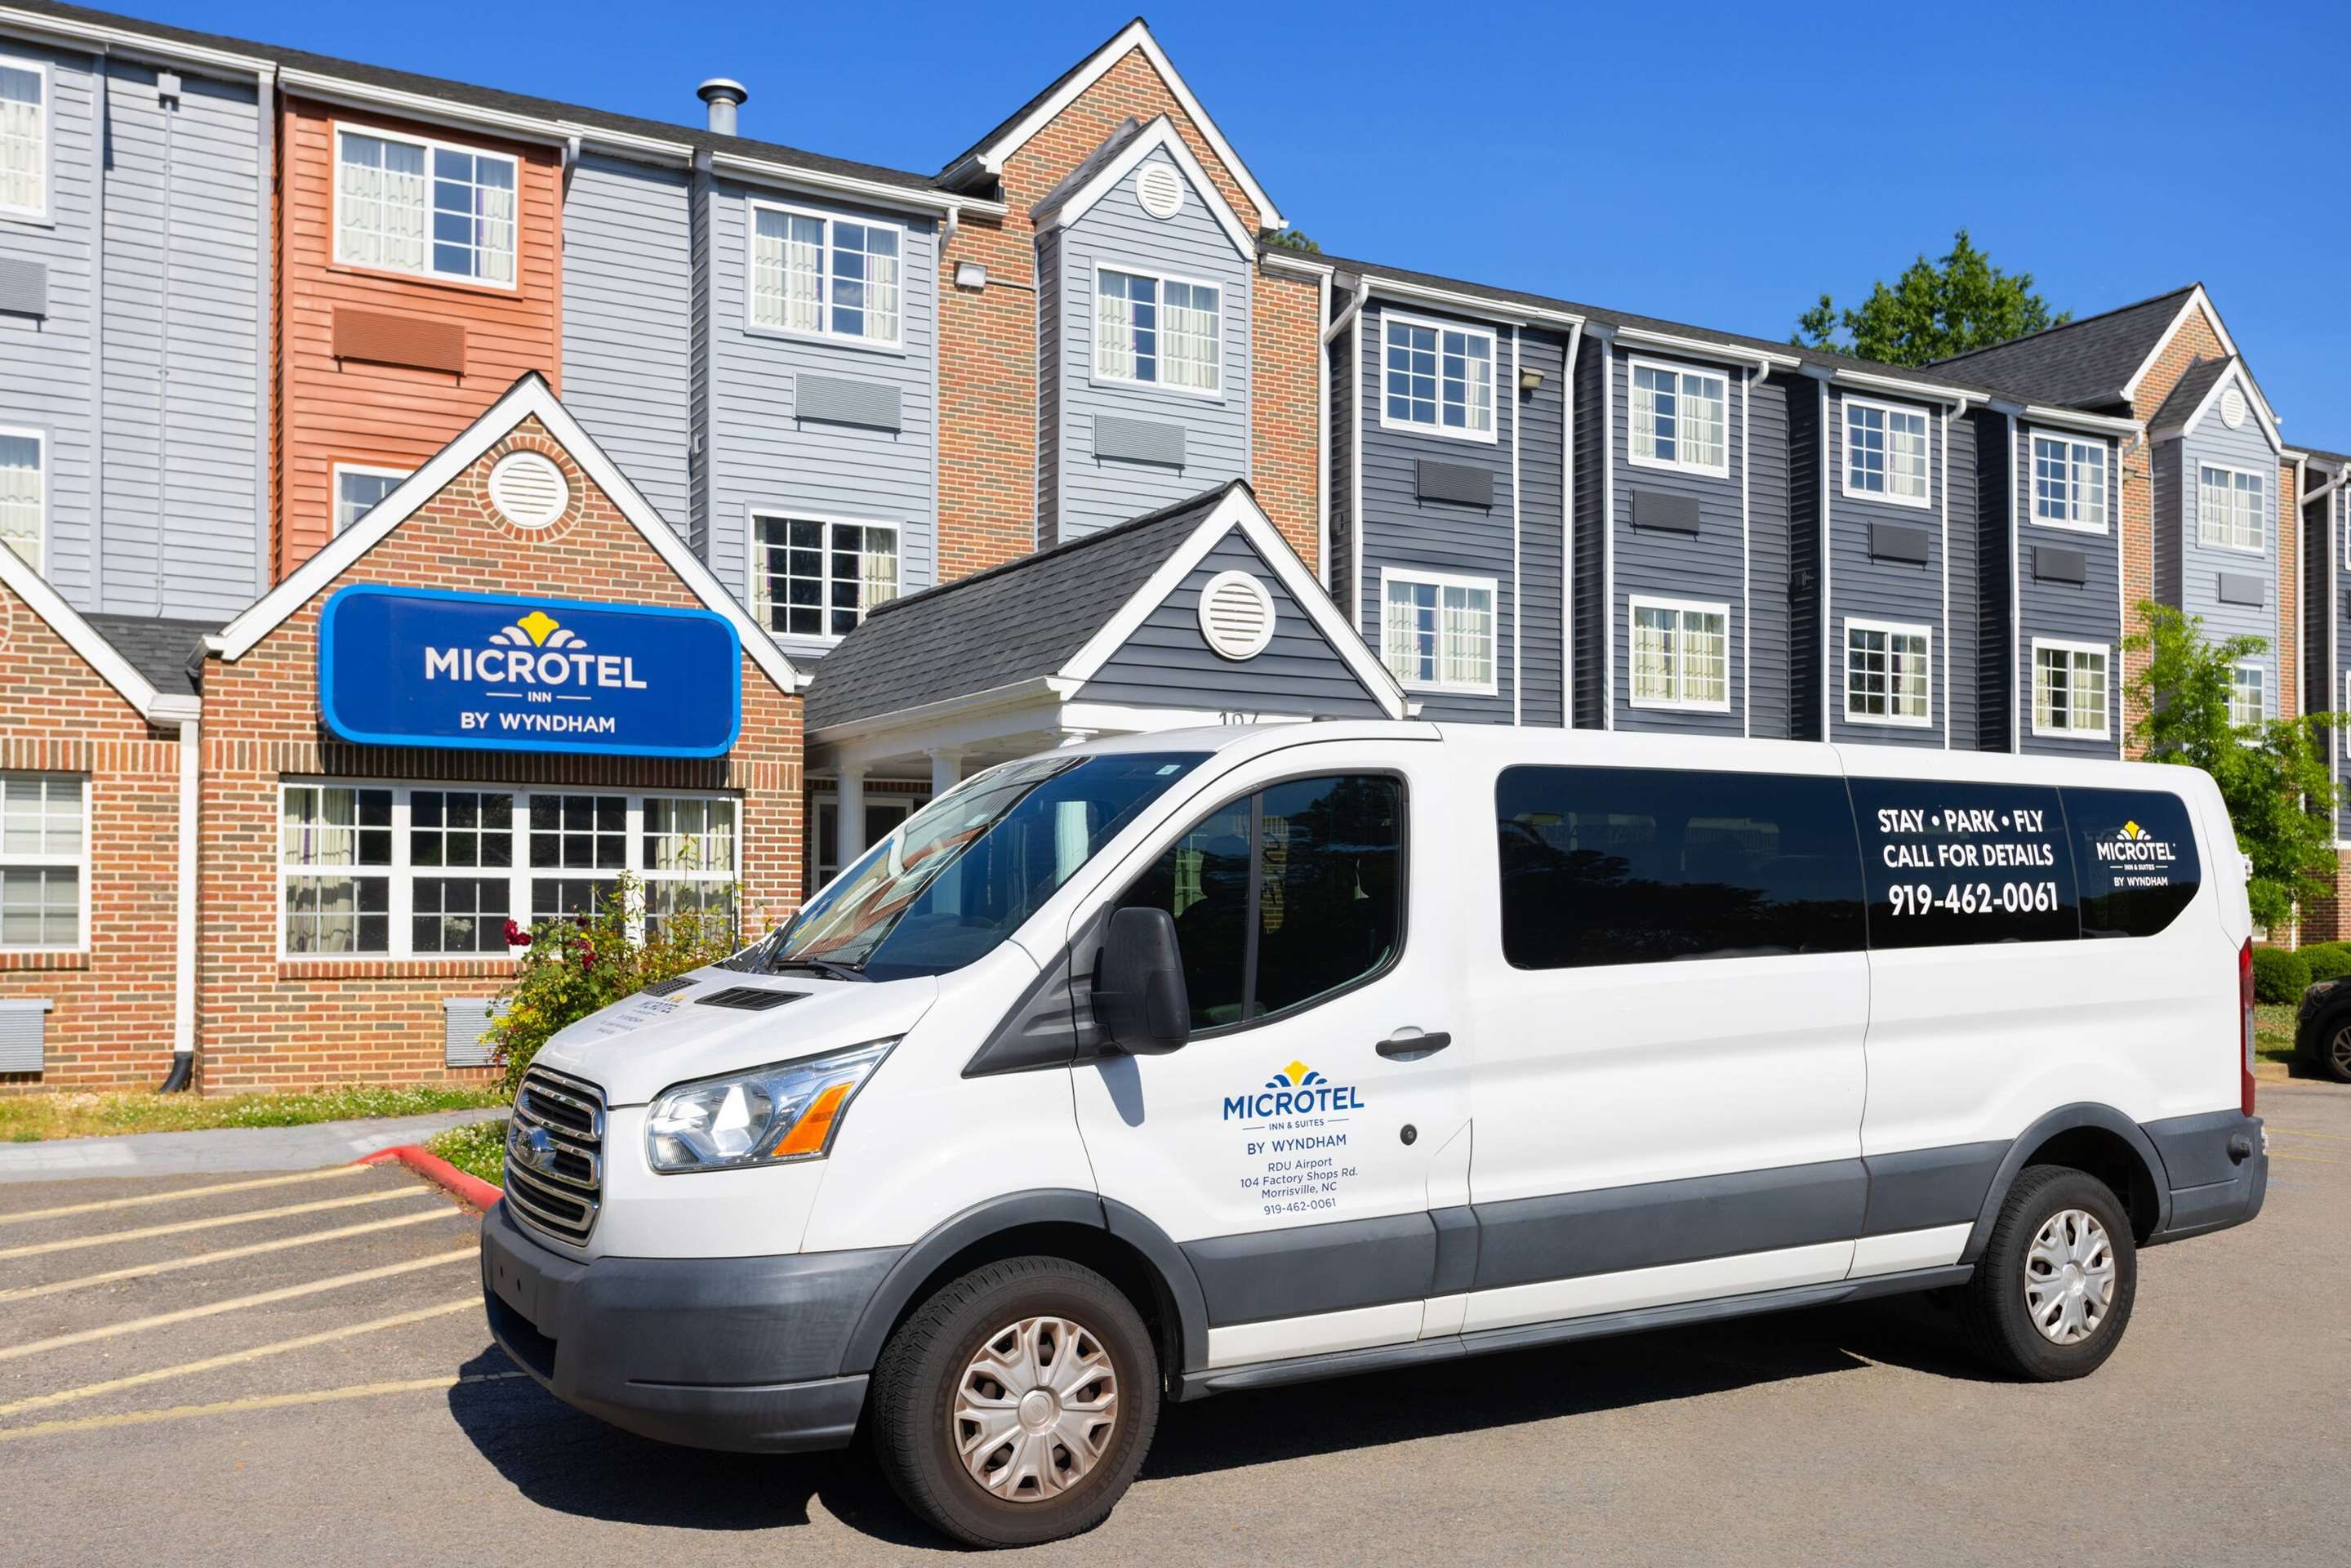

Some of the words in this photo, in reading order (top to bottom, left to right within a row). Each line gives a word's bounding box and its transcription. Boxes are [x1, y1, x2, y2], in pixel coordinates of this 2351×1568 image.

[425, 646, 648, 689] MICROTEL
[528, 691, 552, 703] INN
[461, 711, 490, 729] BY
[499, 712, 615, 733] WYNDHAM
[1877, 808, 1925, 833] STAY
[1944, 809, 2000, 832] PARK
[2012, 809, 2043, 832] FLY
[1883, 844, 1935, 868] CALL
[1937, 844, 1980, 867] FOR
[1982, 843, 2054, 866] DETAILS
[2095, 842, 2176, 861] MICROTEL
[2113, 876, 2125, 887] BY
[2126, 876, 2168, 887] WYNDHAM
[1888, 881, 2058, 915] 919-462-0061
[1223, 1085, 1365, 1120] MICROTEL
[1268, 1122, 1285, 1131] INN
[1286, 1121, 1293, 1129] &
[1294, 1118, 1325, 1129] SUITES
[1247, 1142, 1266, 1156] BY
[1271, 1134, 1347, 1152] WYNDHAM
[1268, 1160, 1292, 1173] RDU
[1294, 1156, 1332, 1170] Airport
[1240, 1177, 1259, 1188] 104
[1262, 1174, 1304, 1186] Factory
[1307, 1170, 1338, 1182] Shops
[1342, 1166, 1358, 1177] Rd.
[1262, 1184, 1319, 1199] Morrisville,
[1321, 1181, 1338, 1192] NC
[1263, 1197, 1337, 1215] 919-462-0061
